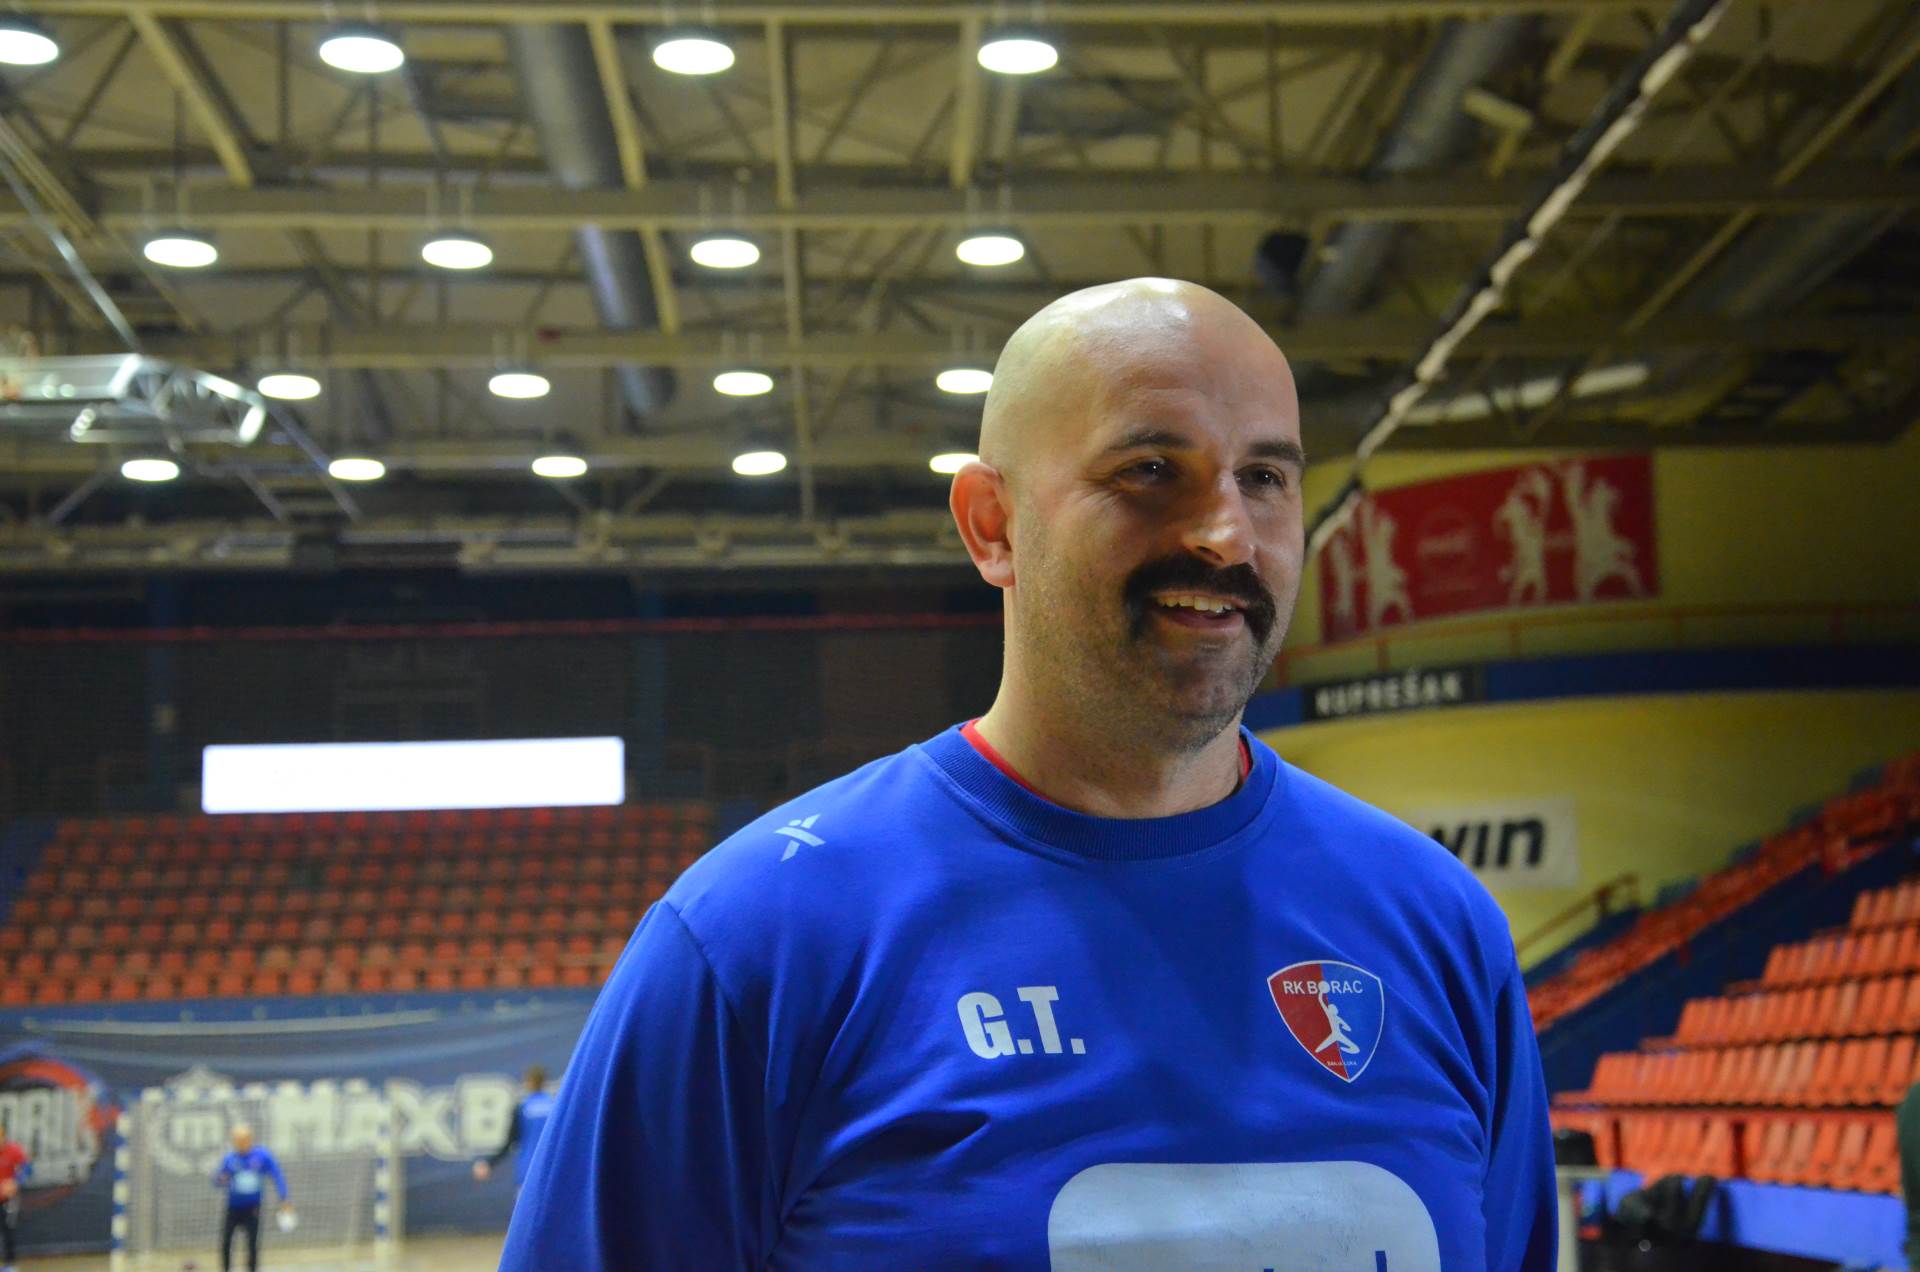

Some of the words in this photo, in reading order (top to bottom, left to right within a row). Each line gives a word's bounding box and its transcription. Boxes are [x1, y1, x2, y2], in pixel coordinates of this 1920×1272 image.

[1283, 980, 1305, 994] RK
[1307, 979, 1363, 994] BORAC
[956, 985, 1087, 1059] G.T.
